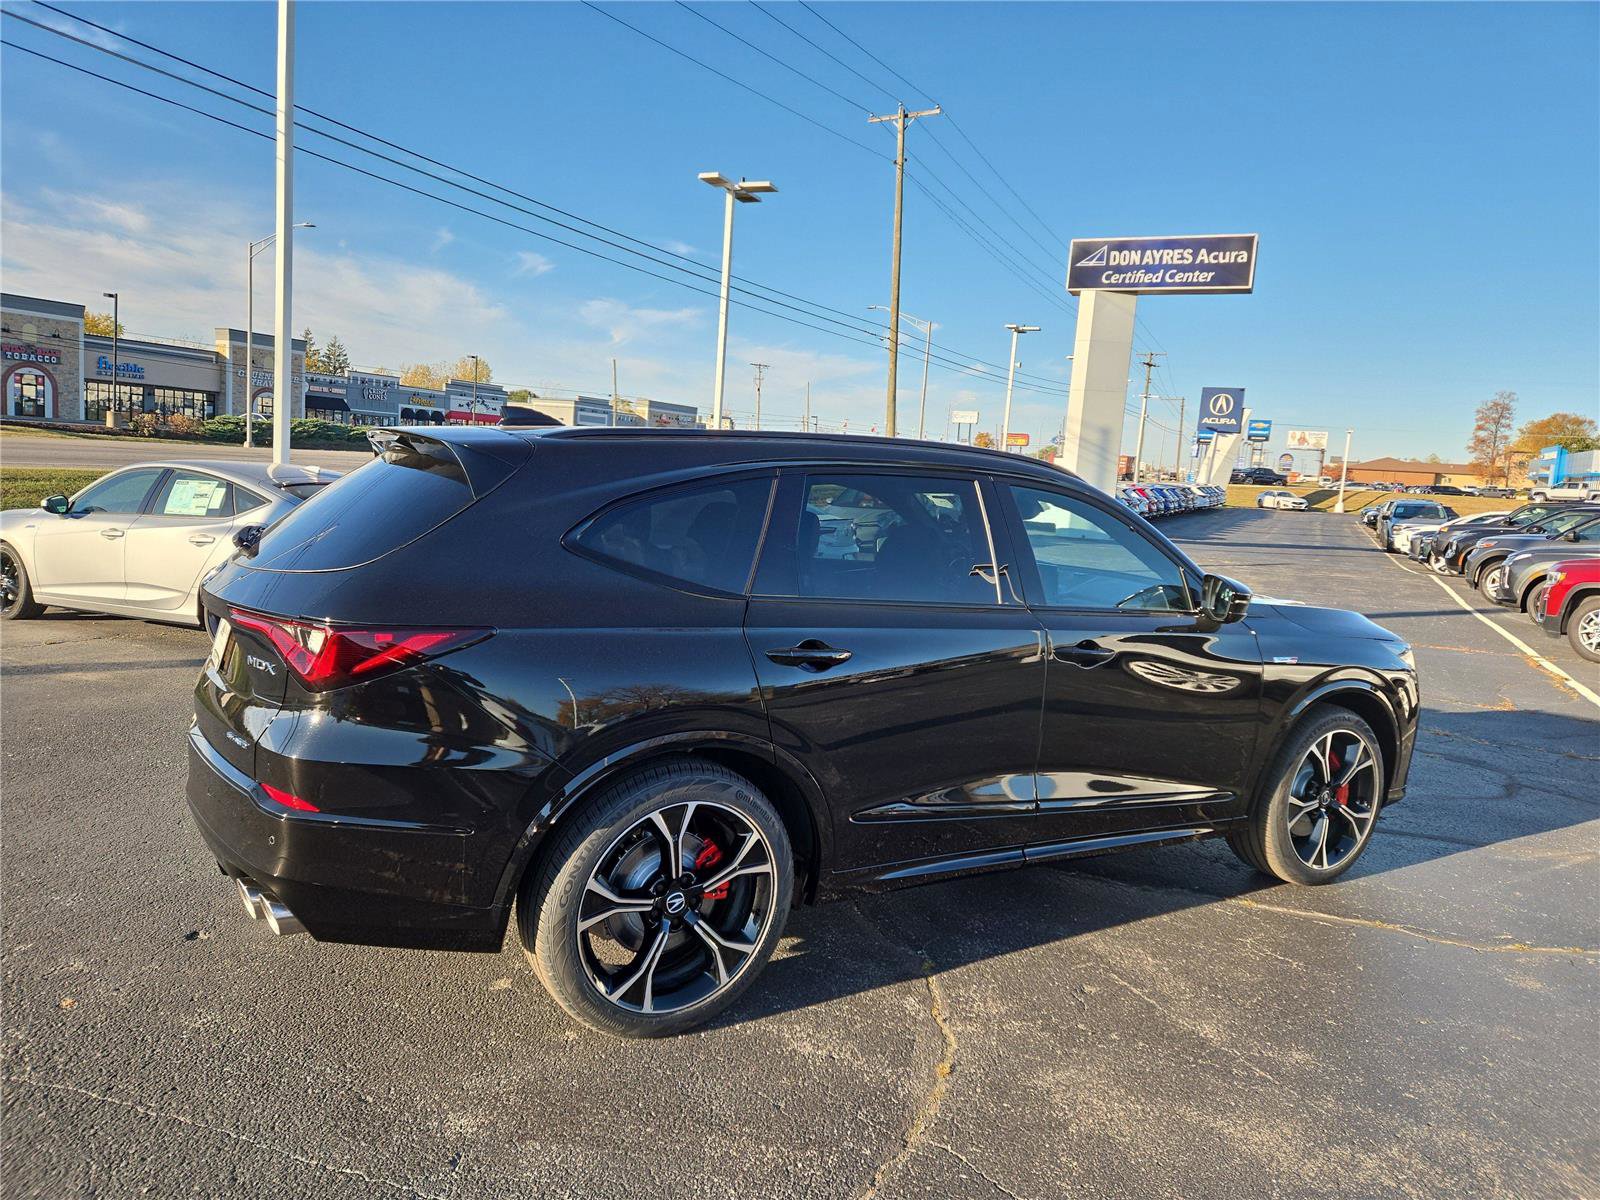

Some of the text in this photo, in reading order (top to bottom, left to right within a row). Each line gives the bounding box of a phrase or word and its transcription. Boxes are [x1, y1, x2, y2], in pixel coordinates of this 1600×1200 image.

[1109, 247, 1248, 266] DON AYRES Acura
[1101, 269, 1216, 284] Certified Center
[5, 351, 57, 364] TOBACCO
[1201, 417, 1237, 425] ACURA
[247, 655, 276, 676] MDX
